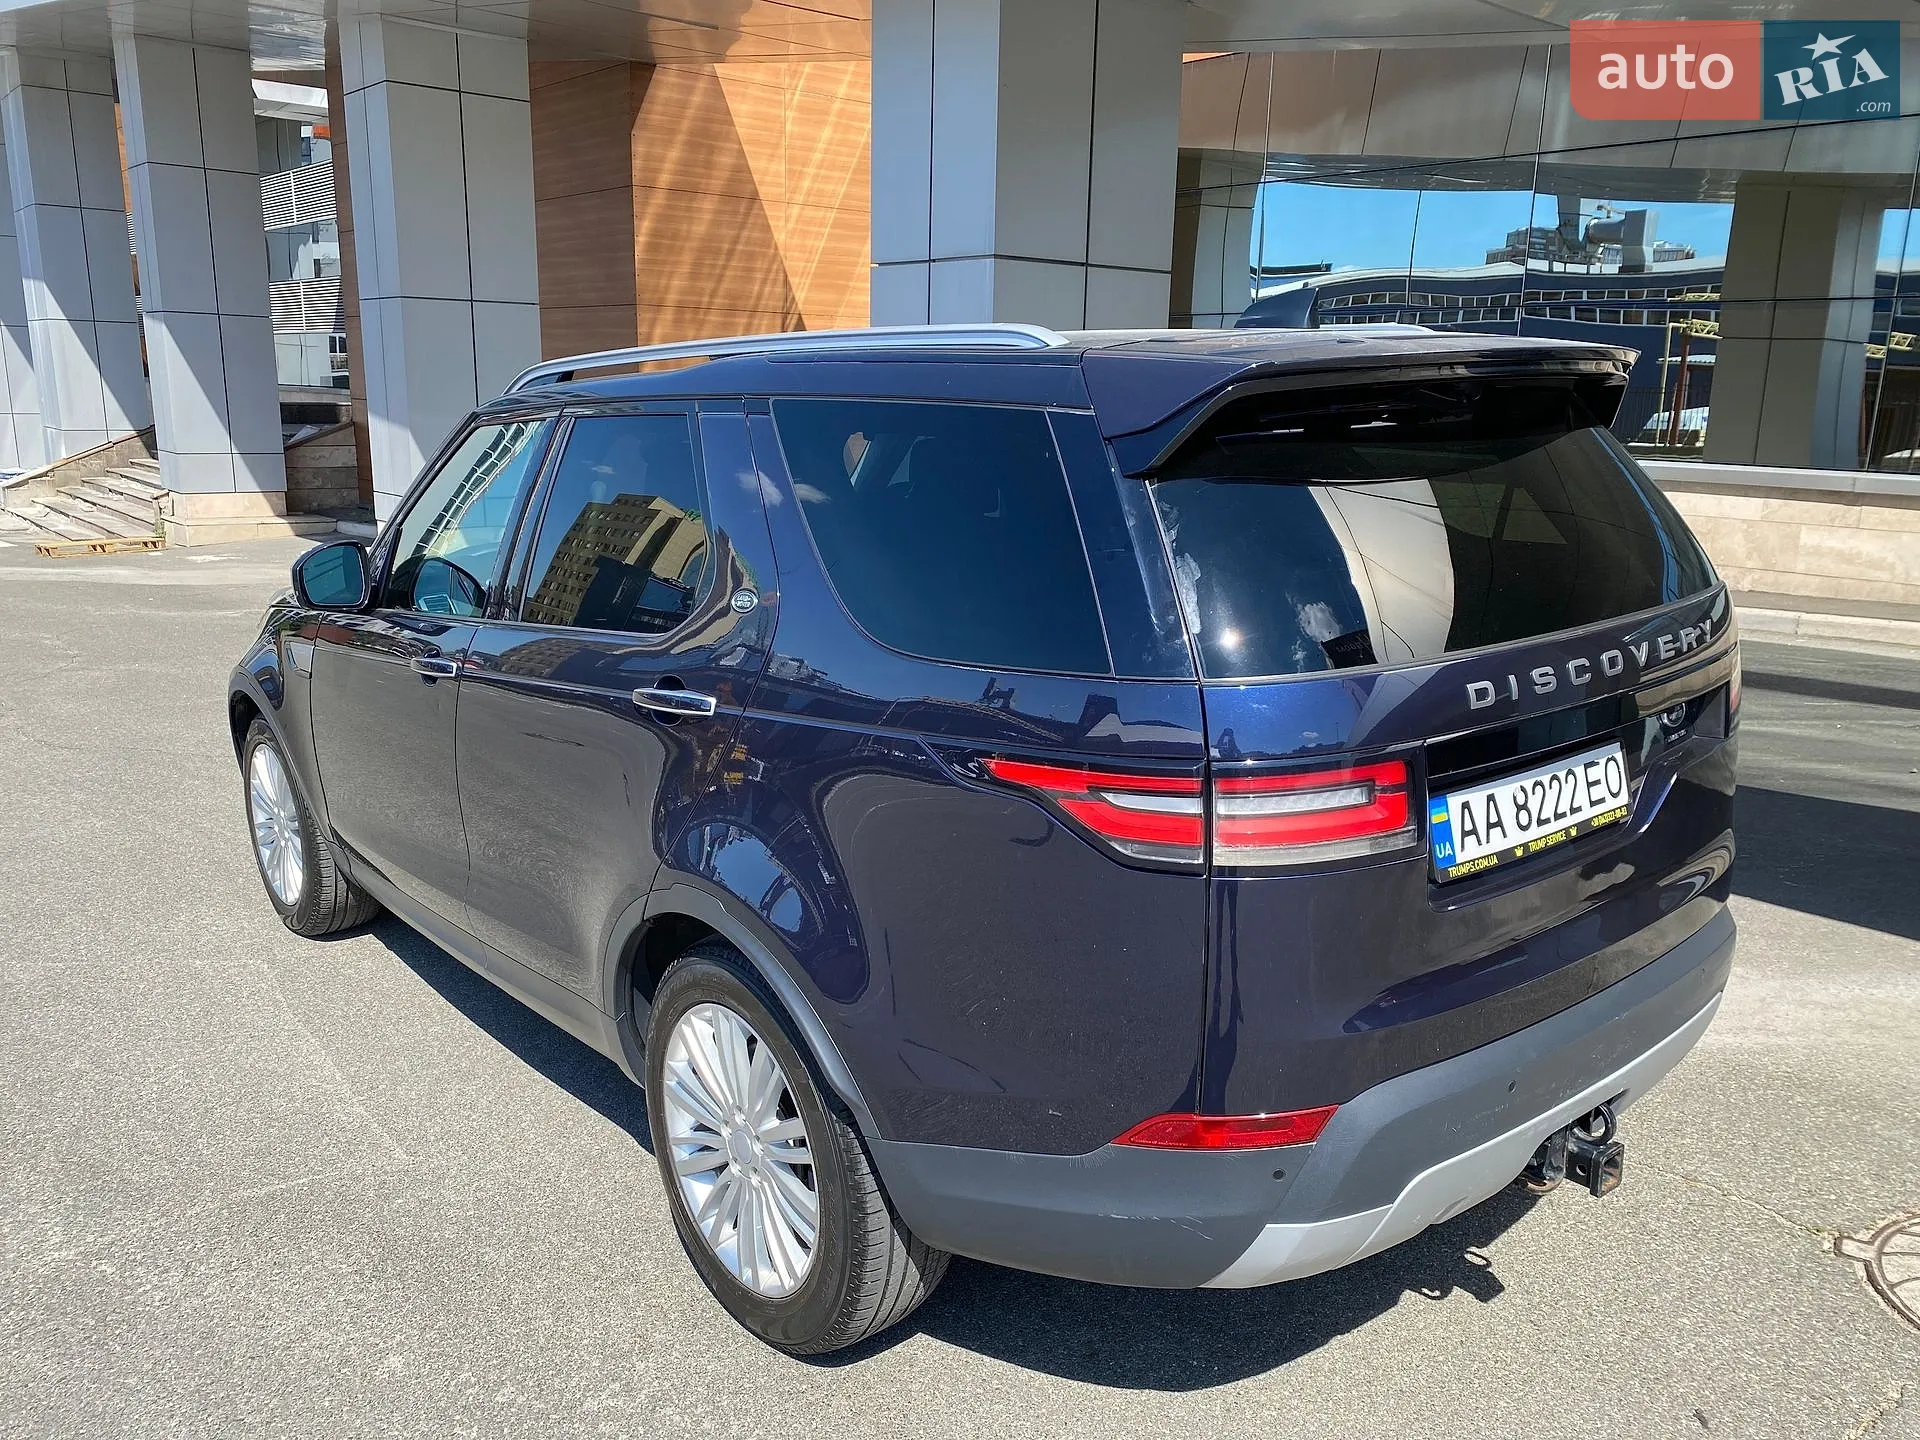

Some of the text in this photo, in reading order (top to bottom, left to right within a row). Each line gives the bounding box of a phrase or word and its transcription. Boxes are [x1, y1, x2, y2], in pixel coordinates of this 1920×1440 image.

[1466, 619, 1712, 710] DISCOVERY
[1460, 755, 1623, 852] AA 8222 EO
[1435, 841, 1454, 859] UA
[1528, 830, 1567, 852] TRUMP SERVICE
[1448, 855, 1498, 878] TRUMPS.COM.UA
